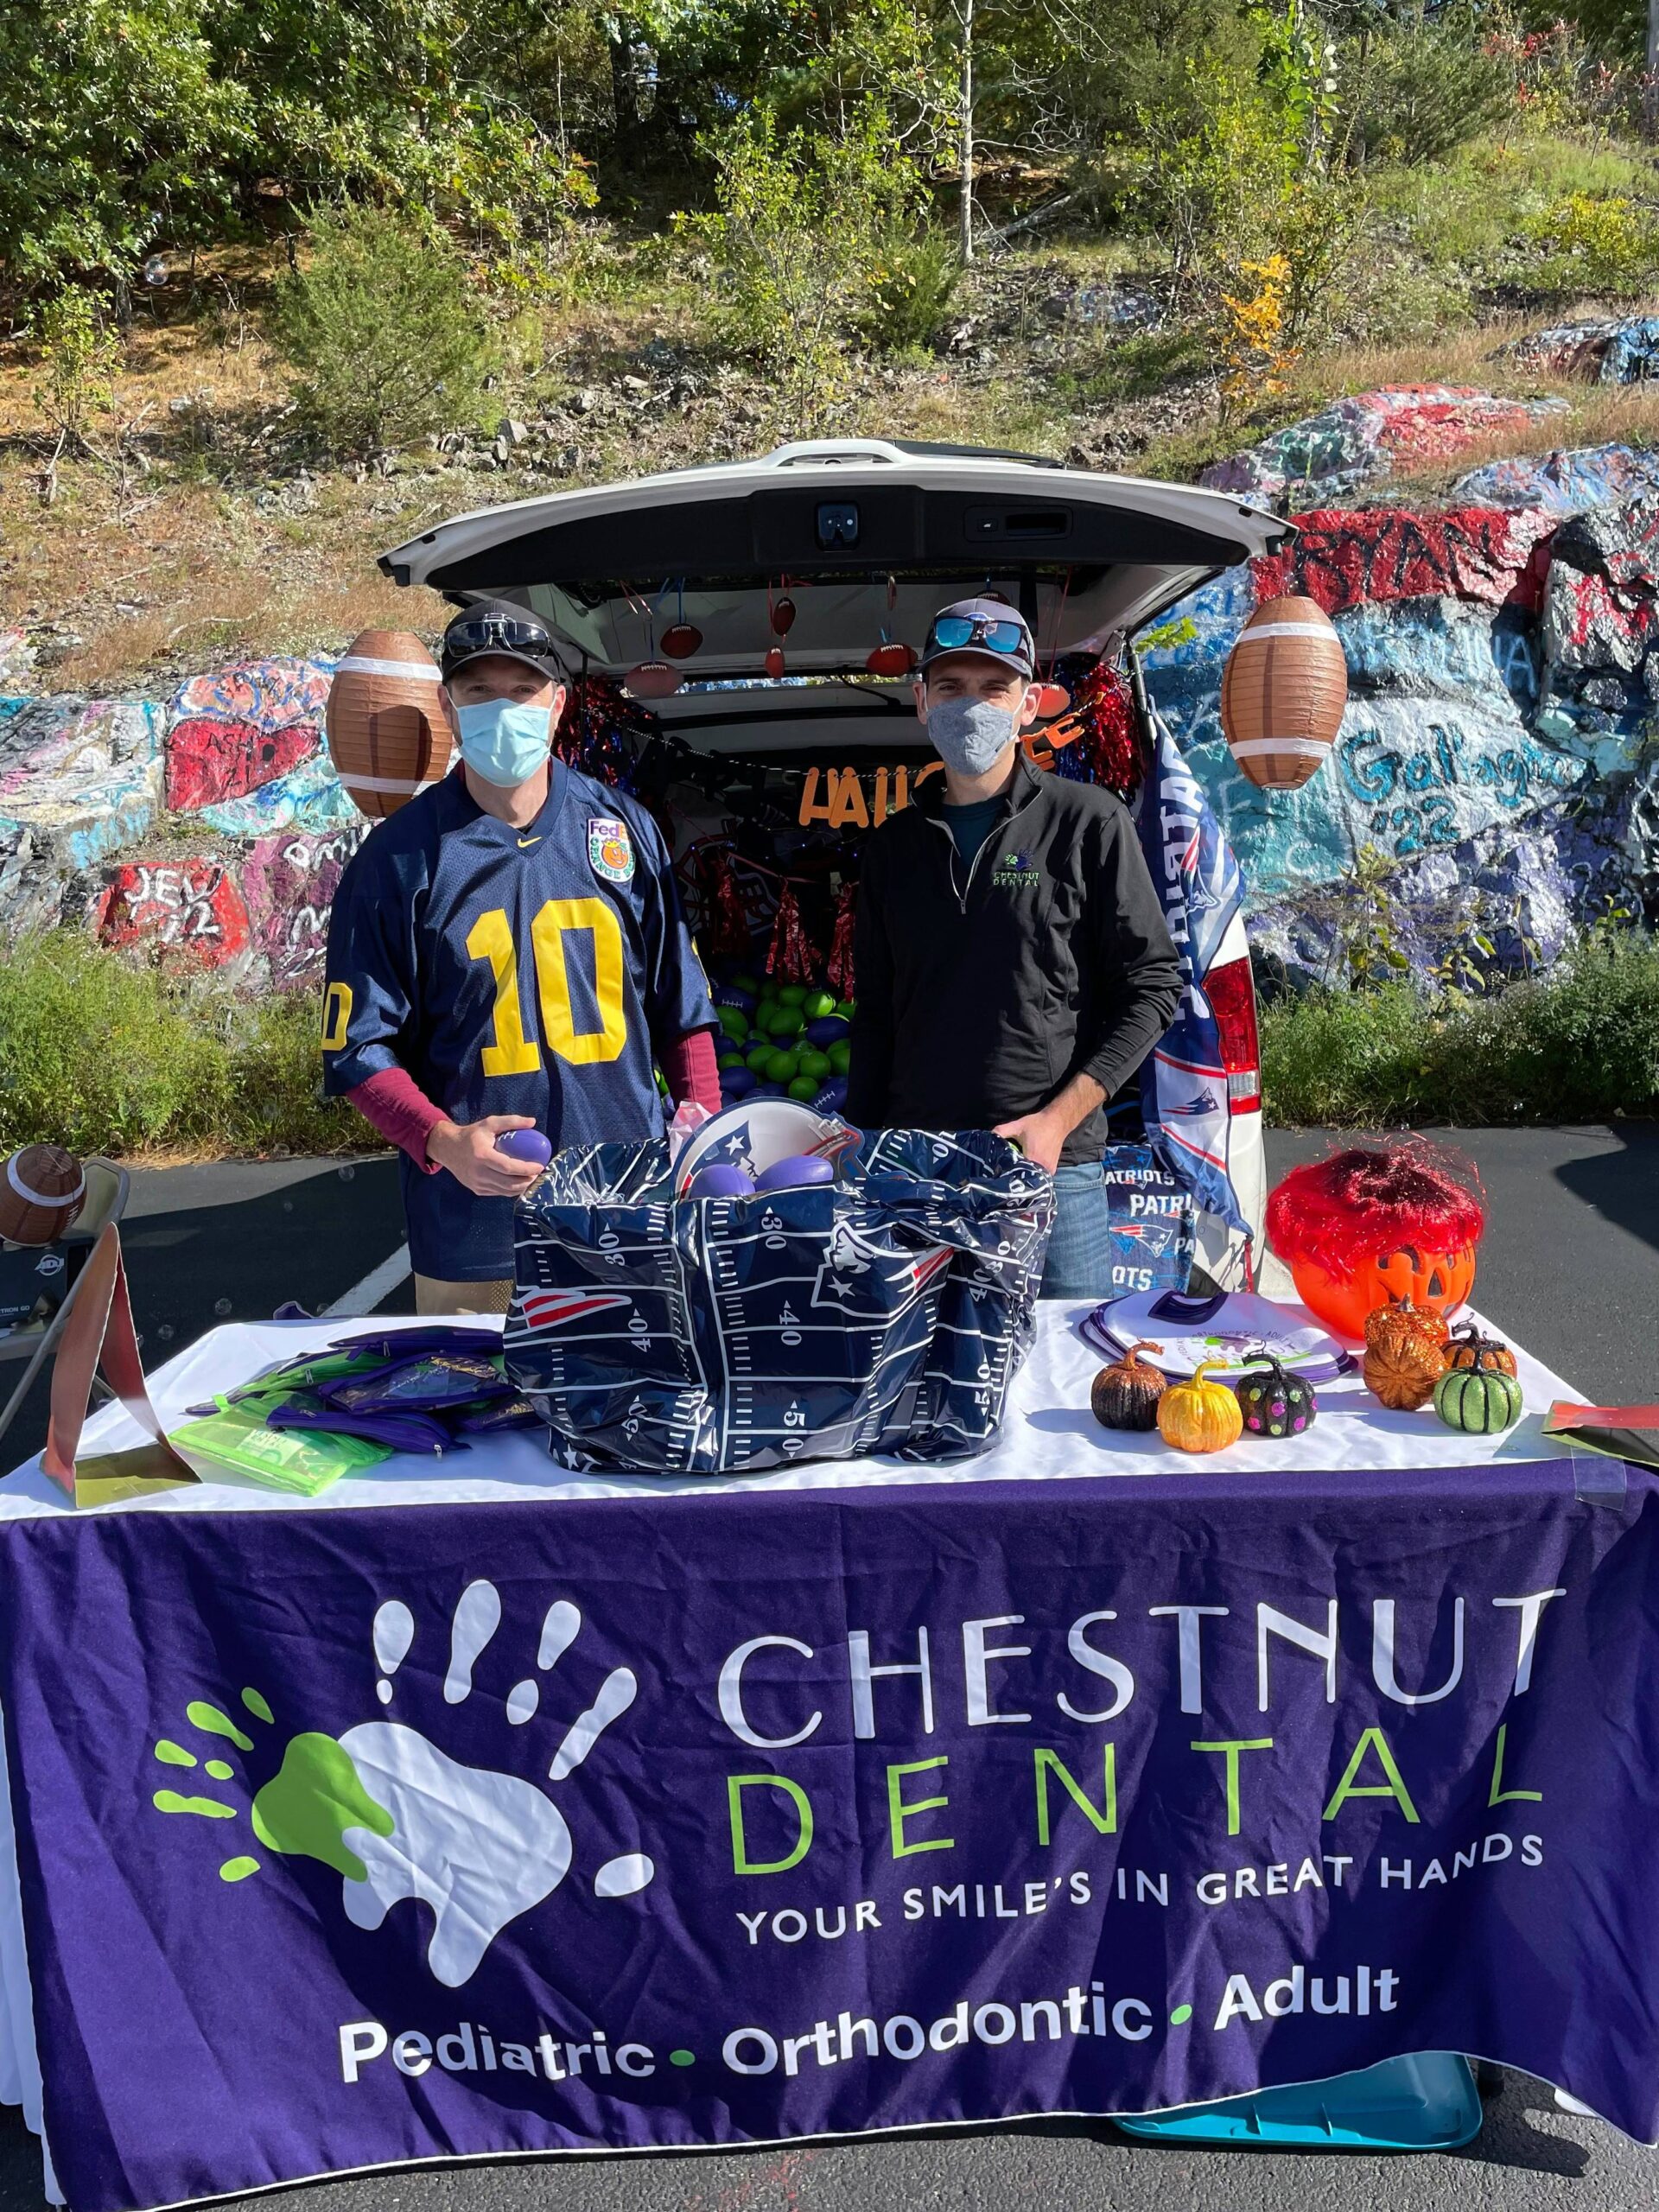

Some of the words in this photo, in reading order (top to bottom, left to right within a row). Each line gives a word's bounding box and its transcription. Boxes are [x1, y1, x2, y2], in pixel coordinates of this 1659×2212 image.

[1295, 519, 1501, 600] RYAN
[590, 820, 629, 839] FedE
[993, 878, 1039, 887] DENTAL
[994, 871, 1040, 880] CHESTNUT
[466, 897, 627, 1077] 10
[1105, 1169, 1175, 1186] ATRIOTS
[761, 1217, 787, 1250] 30
[628, 1317, 652, 1352] 40
[779, 1309, 802, 1346] 40
[783, 1410, 804, 1452] 50
[718, 1588, 1567, 1748] CHESTNUT
[727, 1723, 1543, 1875] DENTAL
[736, 1900, 882, 1945] YOUR
[903, 1872, 1090, 1921] SMILE'S
[1117, 1867, 1169, 1906] IN
[1196, 1855, 1353, 1905] GREAT
[1381, 1832, 1544, 1890] HANDS
[339, 2021, 657, 2083] Pediatric
[721, 1980, 1154, 2076] Orthodontic
[1213, 1964, 1400, 2031] Adult
